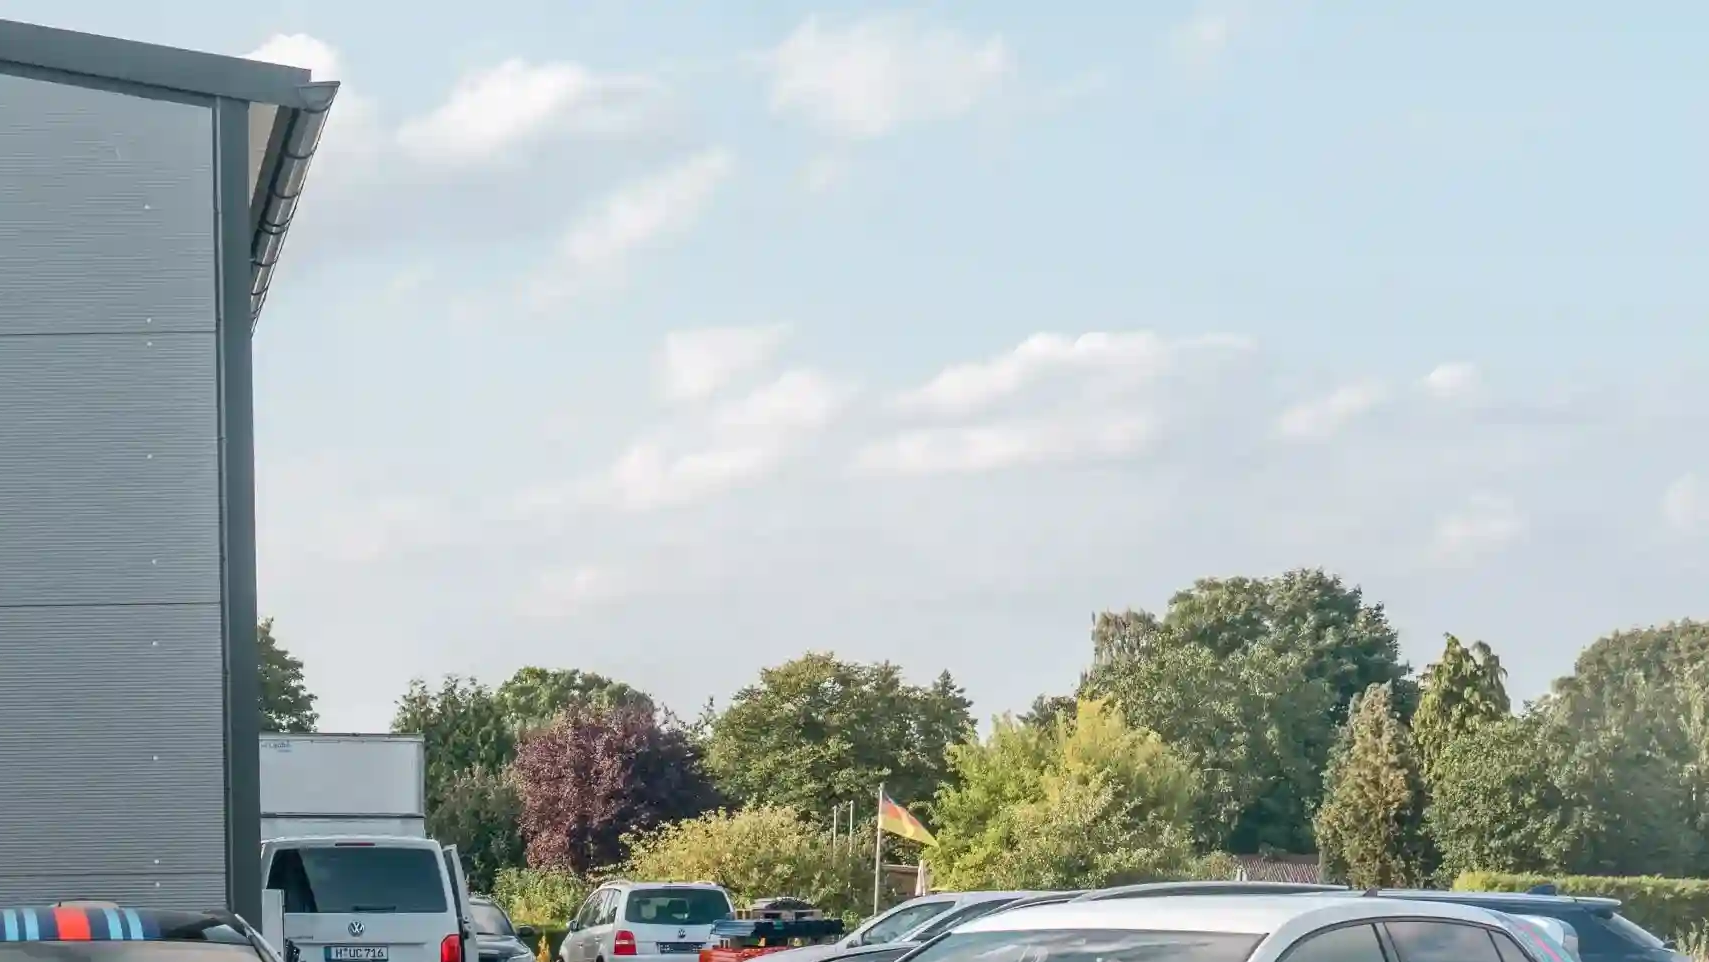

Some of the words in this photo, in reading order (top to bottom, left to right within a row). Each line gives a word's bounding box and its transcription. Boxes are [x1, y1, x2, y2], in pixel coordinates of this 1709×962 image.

[335, 948, 343, 958] H
[349, 948, 363, 958] UC
[364, 948, 384, 958] 716
